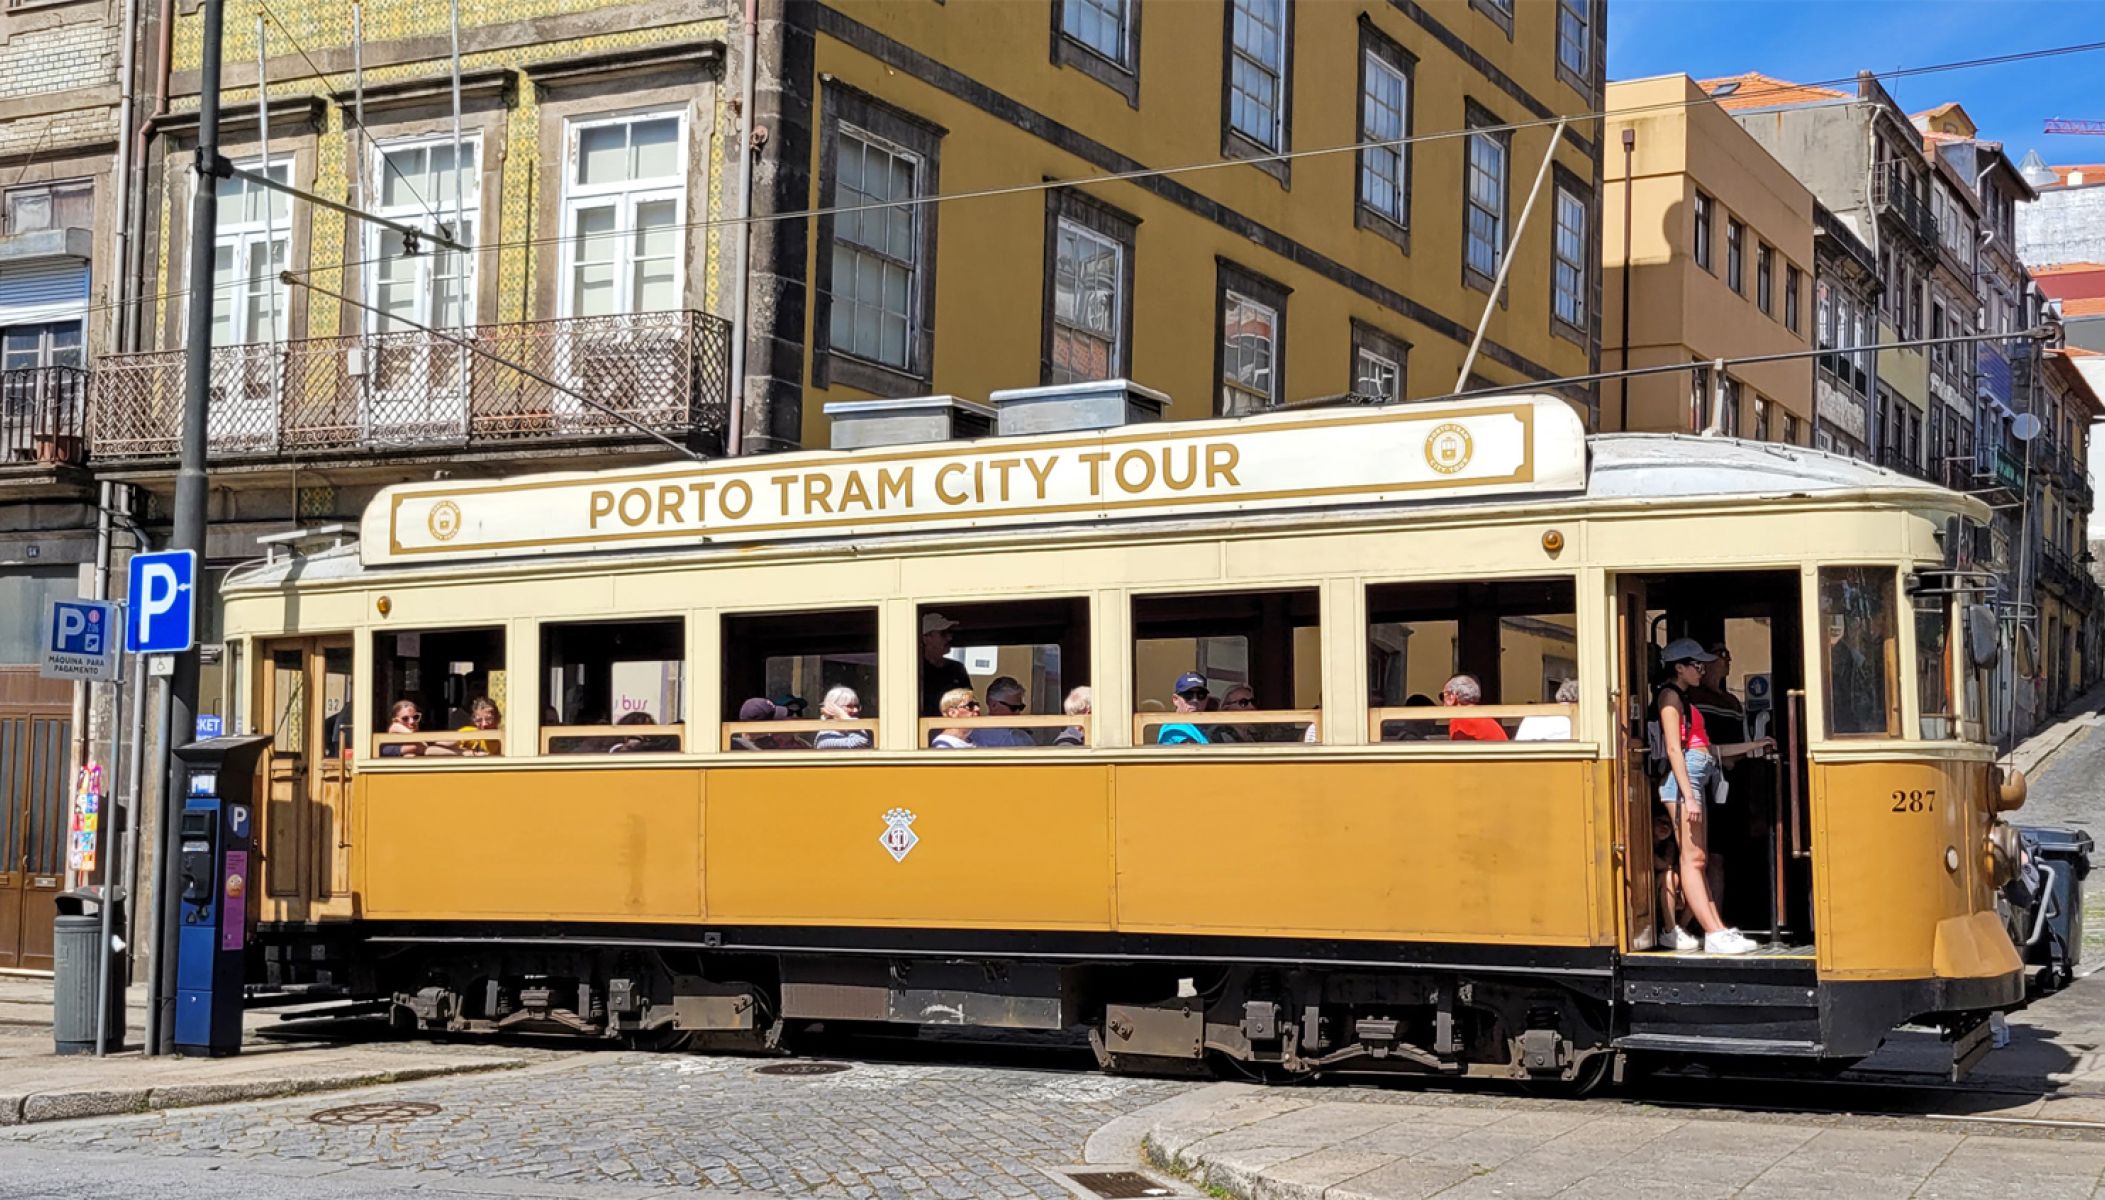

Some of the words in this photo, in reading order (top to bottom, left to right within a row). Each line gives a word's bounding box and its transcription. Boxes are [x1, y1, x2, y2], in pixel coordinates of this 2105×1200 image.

[590, 479, 753, 530] PORTO
[771, 466, 914, 516] TRAM
[935, 456, 1060, 506] CITY
[1079, 443, 1240, 496] TOUR
[140, 563, 177, 643] P
[57, 607, 85, 649] P
[48, 655, 83, 665] MÁQUINA
[86, 658, 104, 666] PARA
[54, 664, 98, 674] PAGAMENTO
[1891, 789, 1935, 812] 287
[233, 806, 247, 832] P
